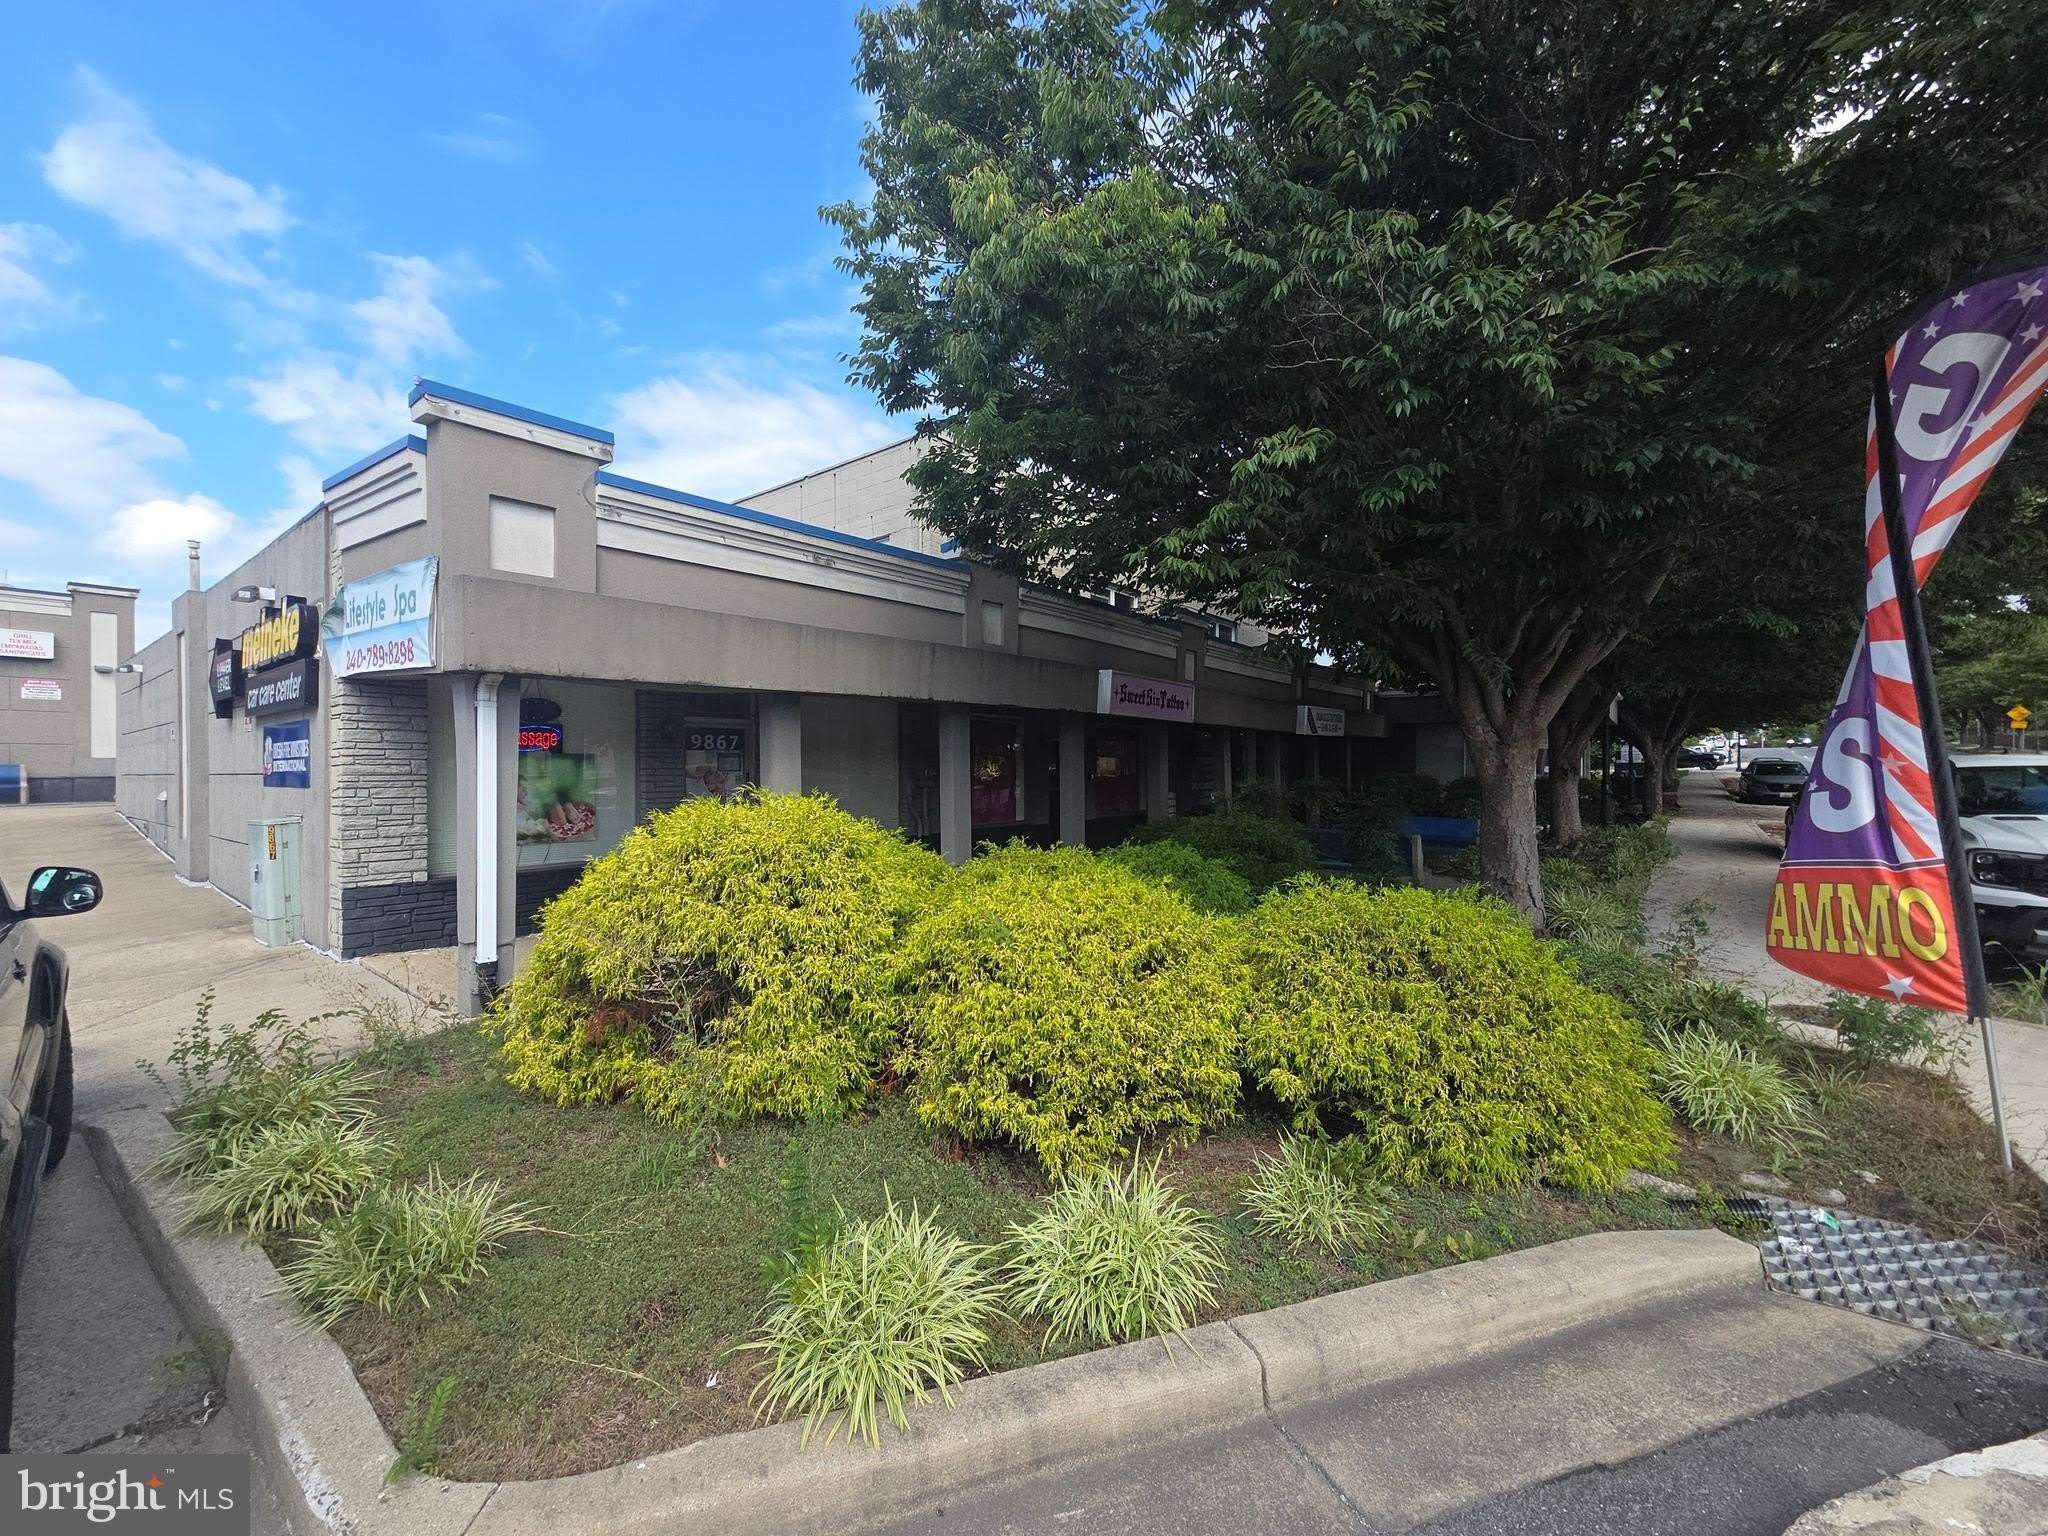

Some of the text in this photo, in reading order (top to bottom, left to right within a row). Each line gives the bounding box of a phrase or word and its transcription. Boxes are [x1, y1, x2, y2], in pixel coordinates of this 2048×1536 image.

[345, 584, 416, 631] Lifestyle Spa
[242, 596, 300, 669] meineke
[247, 672, 302, 709] car care center
[1160, 689, 1185, 710] Tattoo
[690, 734, 739, 749] 9867
[268, 825, 276, 860] 9867
[1766, 881, 1950, 962] AMMO
